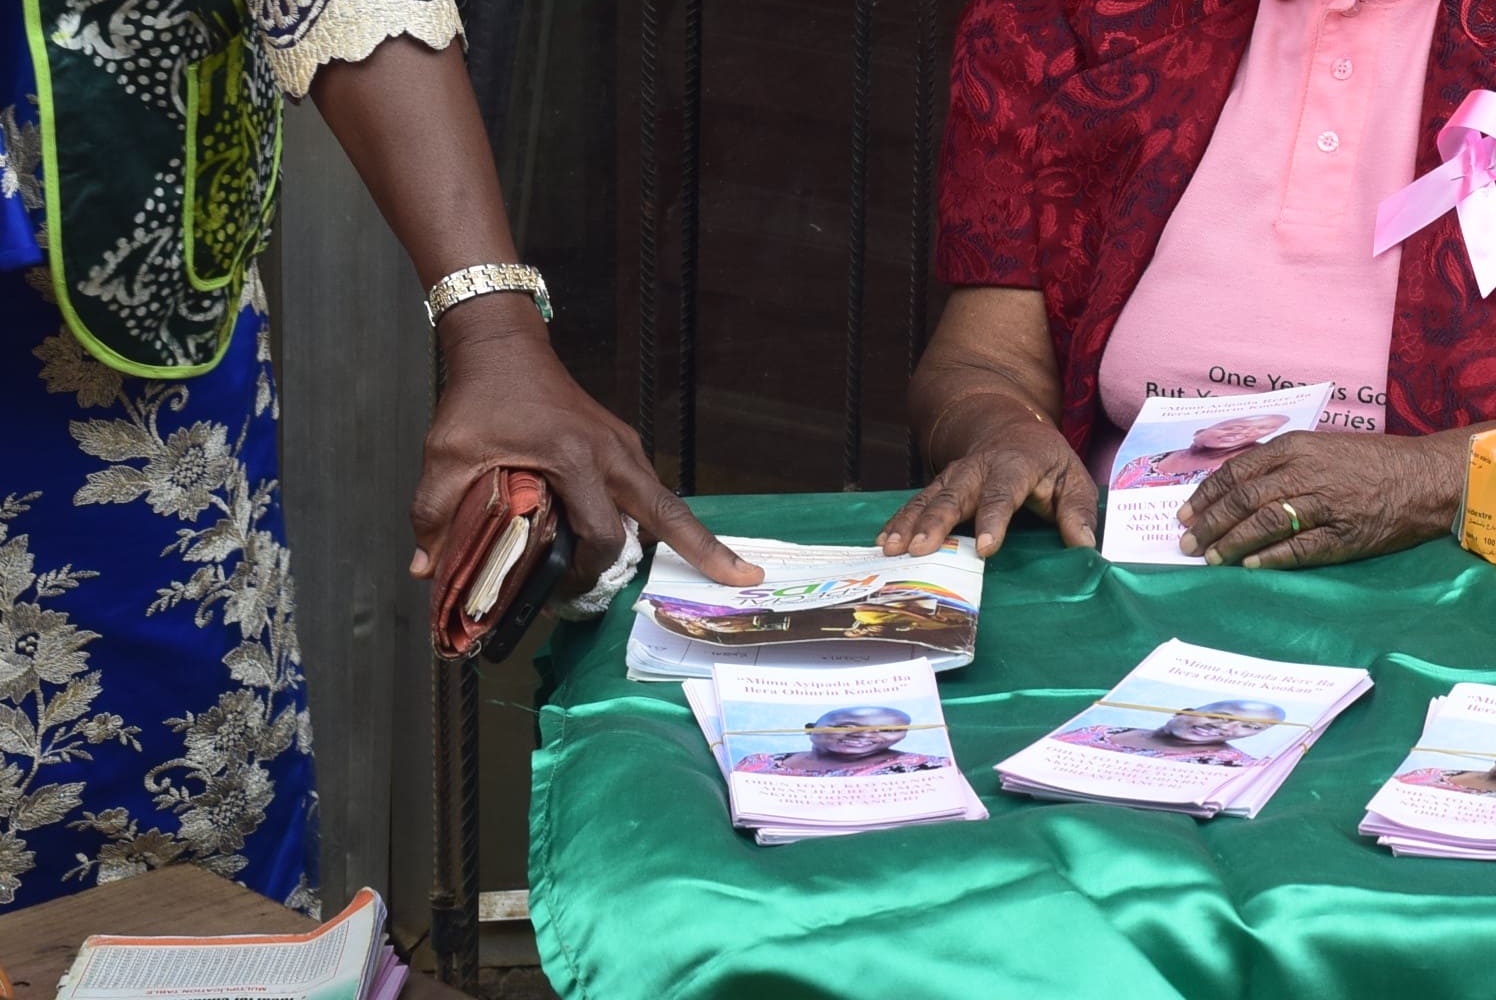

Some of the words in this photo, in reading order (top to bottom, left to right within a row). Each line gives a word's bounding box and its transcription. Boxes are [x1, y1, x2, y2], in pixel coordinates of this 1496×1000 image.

[1146, 381, 1186, 399] But
[1318, 409, 1377, 432] ories
[1208, 365, 1257, 388] One
[1267, 374, 1316, 391] Yea
[1357, 386, 1388, 407] Go
[738, 574, 880, 599] KIDS
